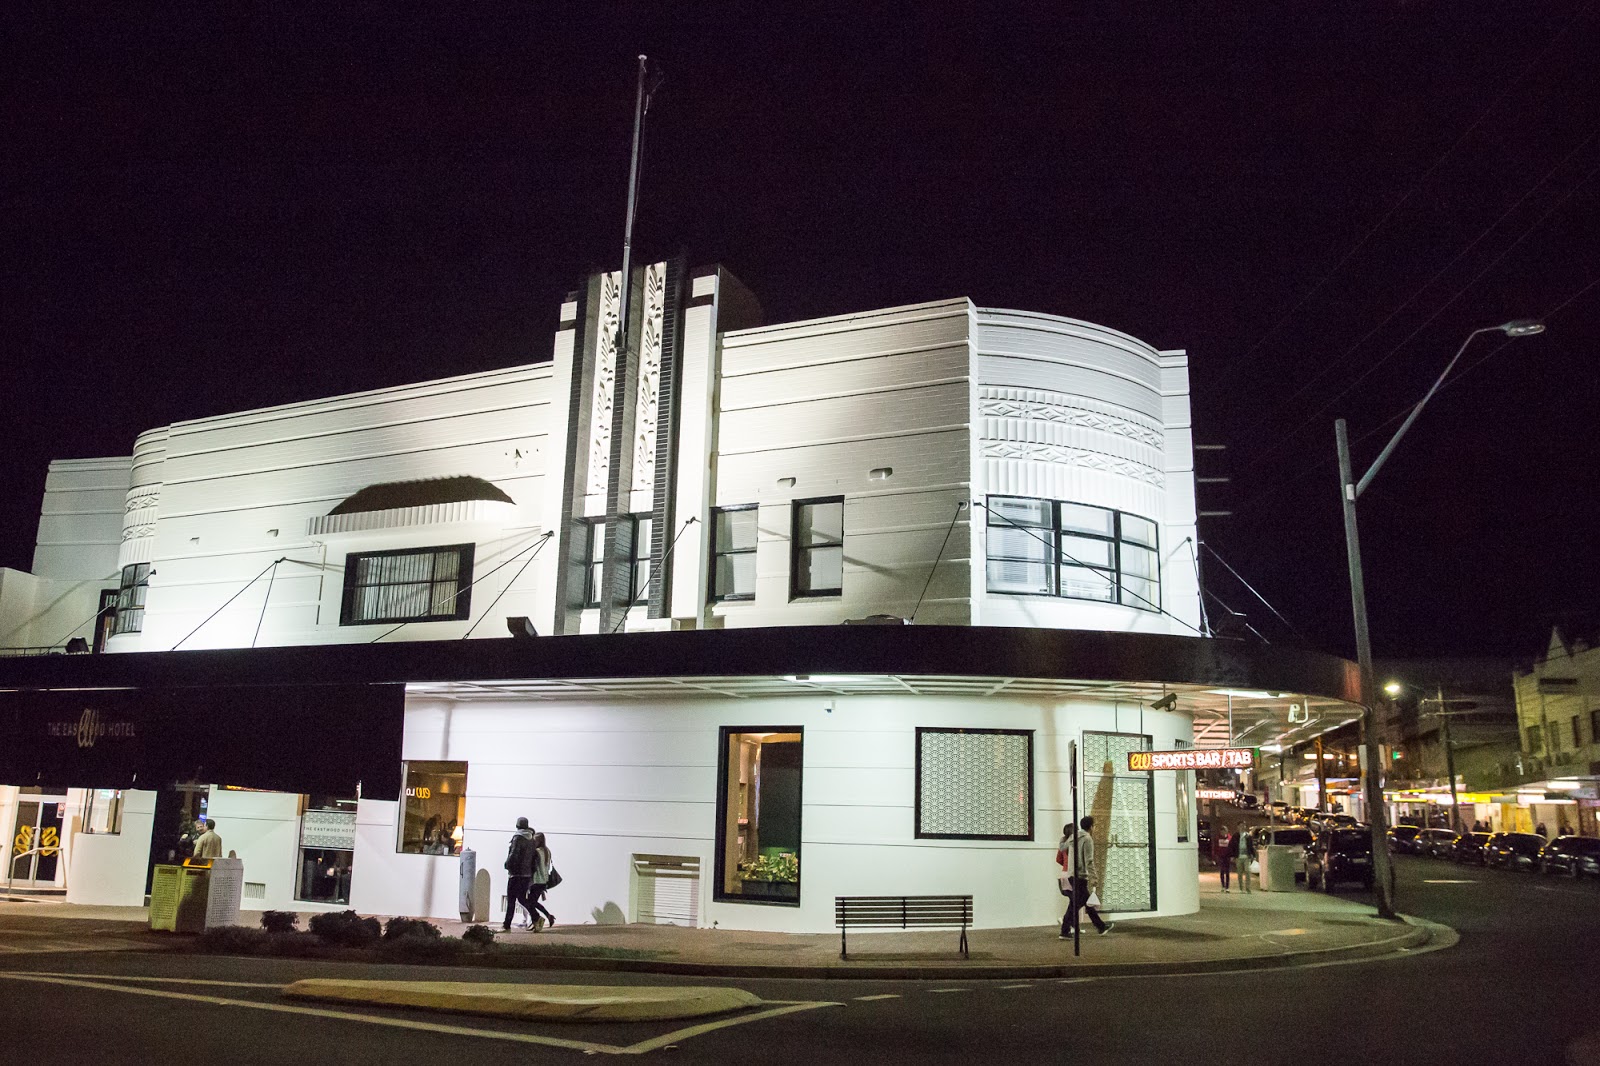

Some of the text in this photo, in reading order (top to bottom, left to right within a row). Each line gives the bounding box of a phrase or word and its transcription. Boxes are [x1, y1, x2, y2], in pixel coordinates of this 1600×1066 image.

[48, 722, 60, 736] THE
[108, 722, 136, 736] HOTEL
[1152, 754, 1195, 767] SPORTS
[1196, 752, 1221, 766] BAR
[1228, 751, 1252, 765] TAB
[1200, 790, 1235, 799] KITCHEN
